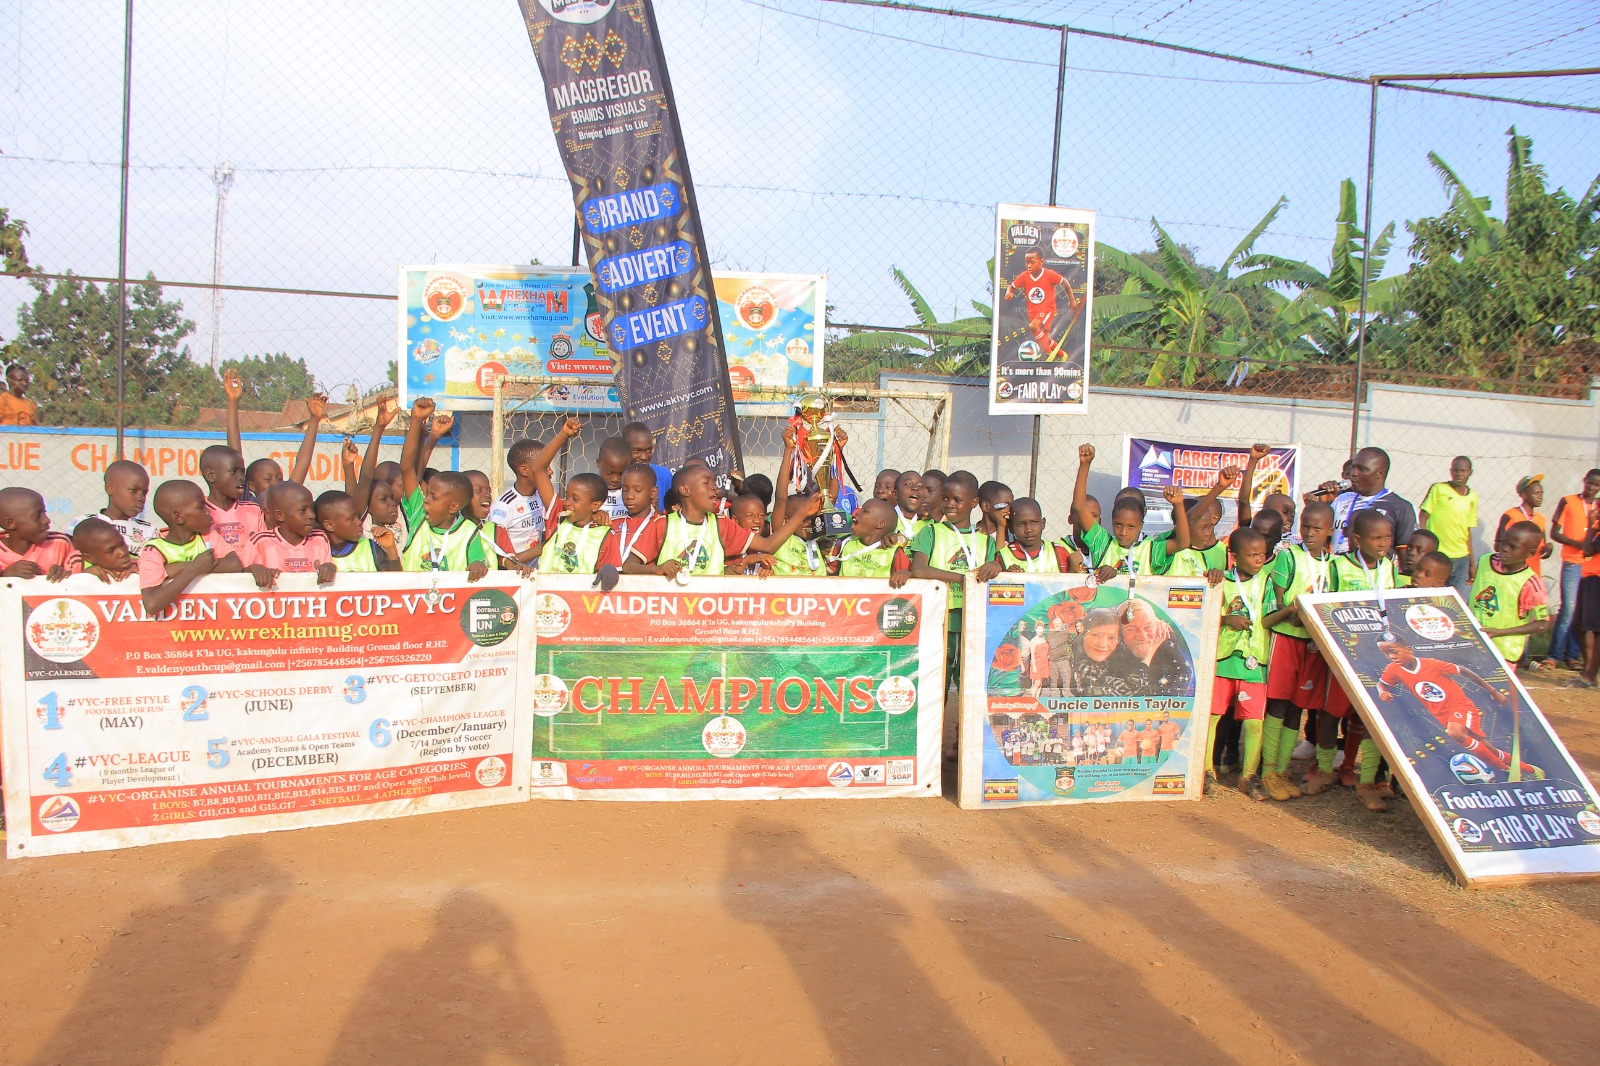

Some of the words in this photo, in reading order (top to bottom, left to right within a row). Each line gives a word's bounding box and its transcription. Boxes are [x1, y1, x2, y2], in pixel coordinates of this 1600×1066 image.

[553, 70, 654, 110] MACGREGOR
[571, 107, 604, 124] BRANDS
[606, 100, 646, 118] VISUALS
[579, 129, 603, 140] Bringing
[605, 126, 624, 136] Ideas
[626, 124, 633, 132] to
[635, 120, 648, 131] Life
[599, 190, 659, 228] BRAND
[1011, 225, 1038, 238] VALDEN
[610, 246, 677, 289] ADVERT
[479, 290, 567, 313] WREXHAM
[630, 304, 688, 344] EVENT
[550, 362, 571, 370] Vist:
[1002, 367, 1013, 375] It's
[1015, 368, 1033, 376] more
[1036, 367, 1051, 376] than
[1054, 368, 1081, 376] 90mins
[0, 442, 41, 471] UE
[1173, 450, 1219, 468] LARGE
[1222, 452, 1281, 471] FORAT
[1173, 468, 1242, 489] PRINTG
[522, 519, 534, 528] ONE
[226, 597, 327, 620] YOUTH
[336, 593, 455, 617] CUP-VYC
[582, 595, 677, 615] VALDEN
[683, 596, 765, 616] YOUTH
[770, 597, 871, 616] CUP-VYC
[1334, 607, 1382, 623] VALDEN
[170, 622, 400, 643] www.wrexhamug.com
[731, 618, 769, 627] kakungulu
[797, 620, 826, 628] Building
[1346, 623, 1370, 632] YOUTH
[1372, 621, 1383, 631] CUP
[165, 650, 193, 659] 36864
[217, 649, 235, 657] UG,
[237, 647, 287, 657] kakungulu
[290, 646, 324, 656] infinity
[327, 644, 364, 654] Building
[367, 642, 400, 651] Ground
[403, 641, 423, 649] floor
[426, 640, 448, 648] R.H2.
[136, 661, 285, 674] E.valdenyouthcup@gmail.com
[474, 668, 509, 679] DERBY
[209, 688, 295, 700] #VYC-SCHOOLS
[299, 686, 333, 695] DERBY
[344, 675, 367, 704] 3
[411, 683, 476, 697] (SEPTEMBER)
[571, 675, 875, 715] CHAMPIONS
[37, 691, 63, 730] 1
[68, 697, 132, 707] #VYC-FREE
[136, 695, 170, 705] STYLE
[85, 707, 128, 715] FOOTBALL
[182, 685, 209, 721] 2
[245, 699, 293, 715] (JUNE)
[1047, 699, 1089, 710] Uncle
[1093, 699, 1140, 710] Dennis
[1144, 698, 1187, 712] Taylor
[100, 716, 144, 731] (MAY)
[392, 713, 472, 727] #VYC-CHAMPIONS
[473, 710, 505, 719] LEAGUE
[231, 736, 295, 746] #VYC-ANNUAL
[297, 734, 320, 742] GALA
[322, 731, 361, 740] FESTIVAL
[369, 718, 392, 748] 6
[397, 720, 507, 741] (December/January)
[237, 746, 272, 756] Academy
[309, 743, 329, 751] Open
[331, 740, 356, 749] Teams
[411, 739, 430, 748] 7/14
[432, 737, 450, 747] Days
[453, 736, 463, 744] of
[464, 734, 492, 743] Soccer
[420, 746, 454, 758] (Region
[456, 744, 467, 754] by
[468, 742, 490, 752] vote)
[75, 751, 190, 768] #VYC-LEAGUE
[207, 736, 231, 769] 5
[252, 752, 339, 772] (DECEMBER)
[43, 752, 73, 787] 4
[110, 767, 138, 775] months
[140, 766, 161, 775] League
[164, 765, 175, 773] of
[88, 788, 197, 804] #VYC-ORGANISE
[200, 783, 252, 796] ANNUAL
[254, 775, 346, 792] TOURNAMENTS
[349, 772, 372, 782] FOR
[374, 771, 397, 780] AGE
[399, 762, 469, 777] CATEGORIES:
[102, 776, 125, 786] Player
[127, 774, 176, 784] Development
[363, 782, 381, 791] and
[383, 780, 405, 789] Open
[407, 778, 422, 787] age
[425, 774, 447, 785] (Club
[449, 771, 471, 781] level)
[199, 807, 236, 818] G11,G13
[239, 804, 257, 813] and
[260, 801, 296, 812] G15,G17
[311, 795, 363, 807] 3.NETBALL
[374, 785, 433, 800] 4.ATHLETICS
[1441, 789, 1516, 810] Football
[1513, 788, 1545, 806] For
[1545, 786, 1583, 803] Fun
